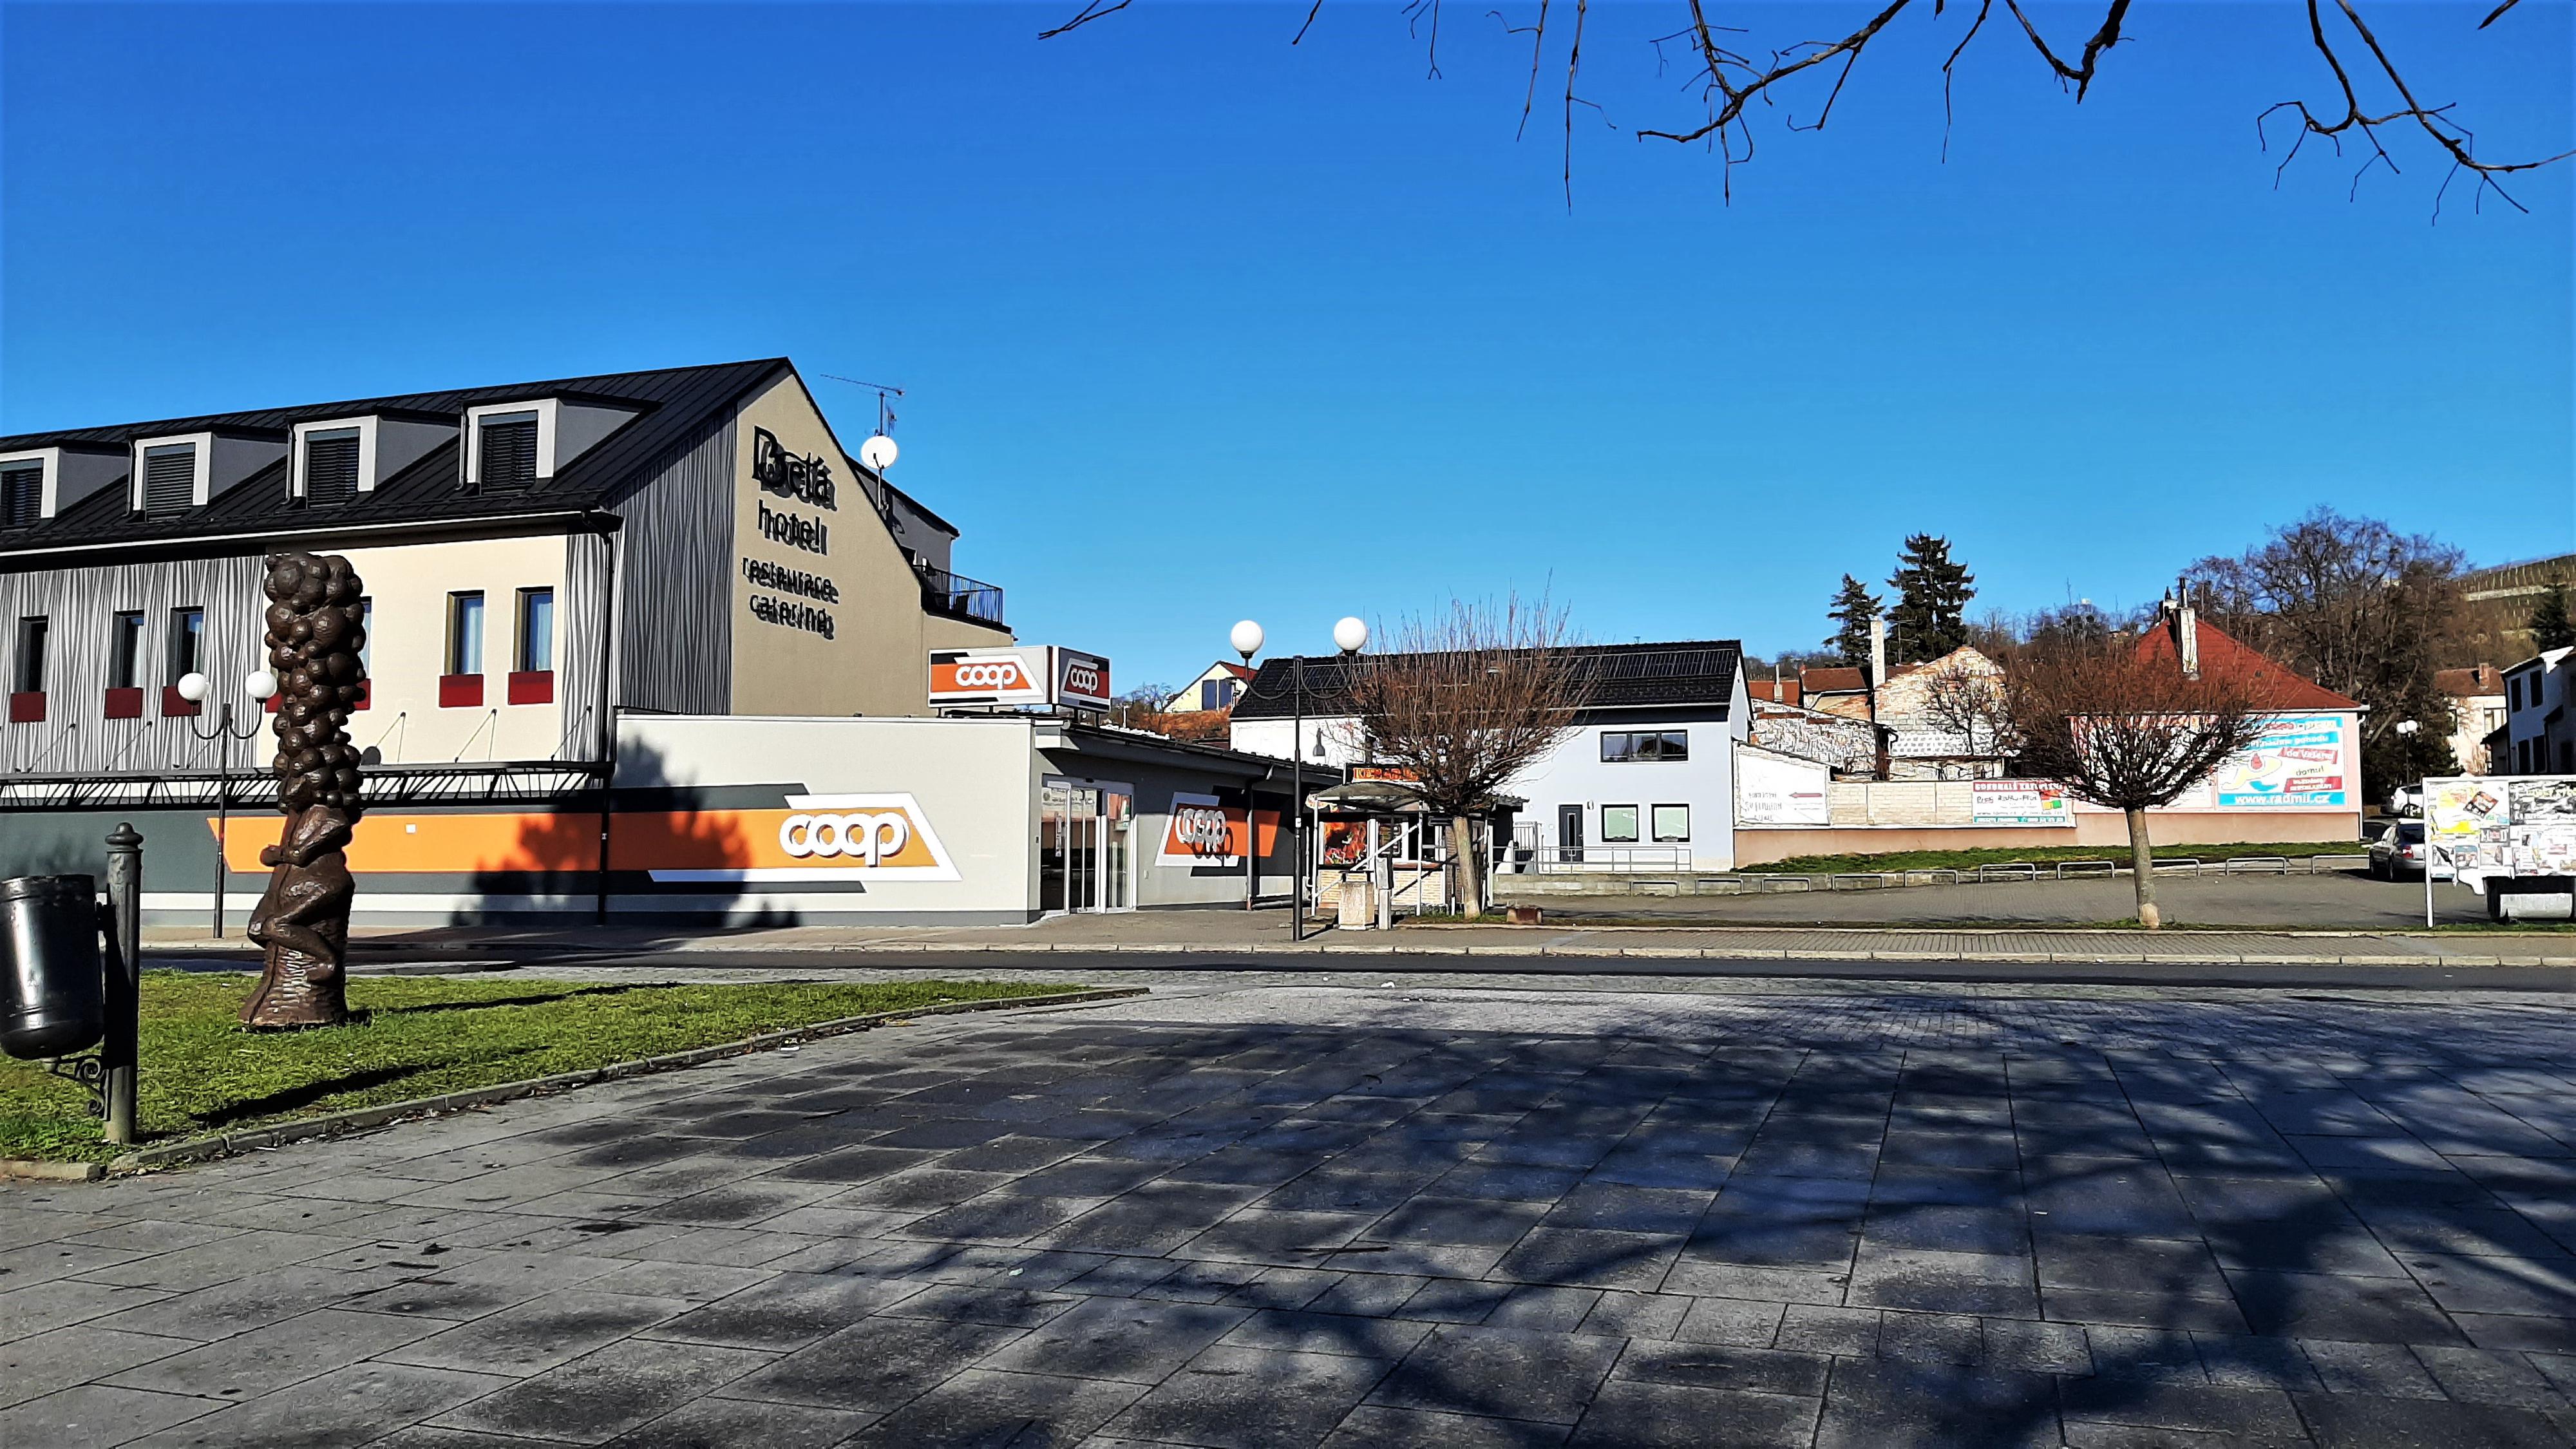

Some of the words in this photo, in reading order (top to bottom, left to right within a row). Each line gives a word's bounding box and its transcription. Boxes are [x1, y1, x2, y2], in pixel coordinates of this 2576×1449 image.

[758, 498, 820, 546] hotel
[743, 557, 833, 594] restaurace
[750, 594, 827, 634] catering
[956, 664, 1018, 690] coop
[1070, 668, 1098, 694] coop
[779, 812, 910, 867] coop
